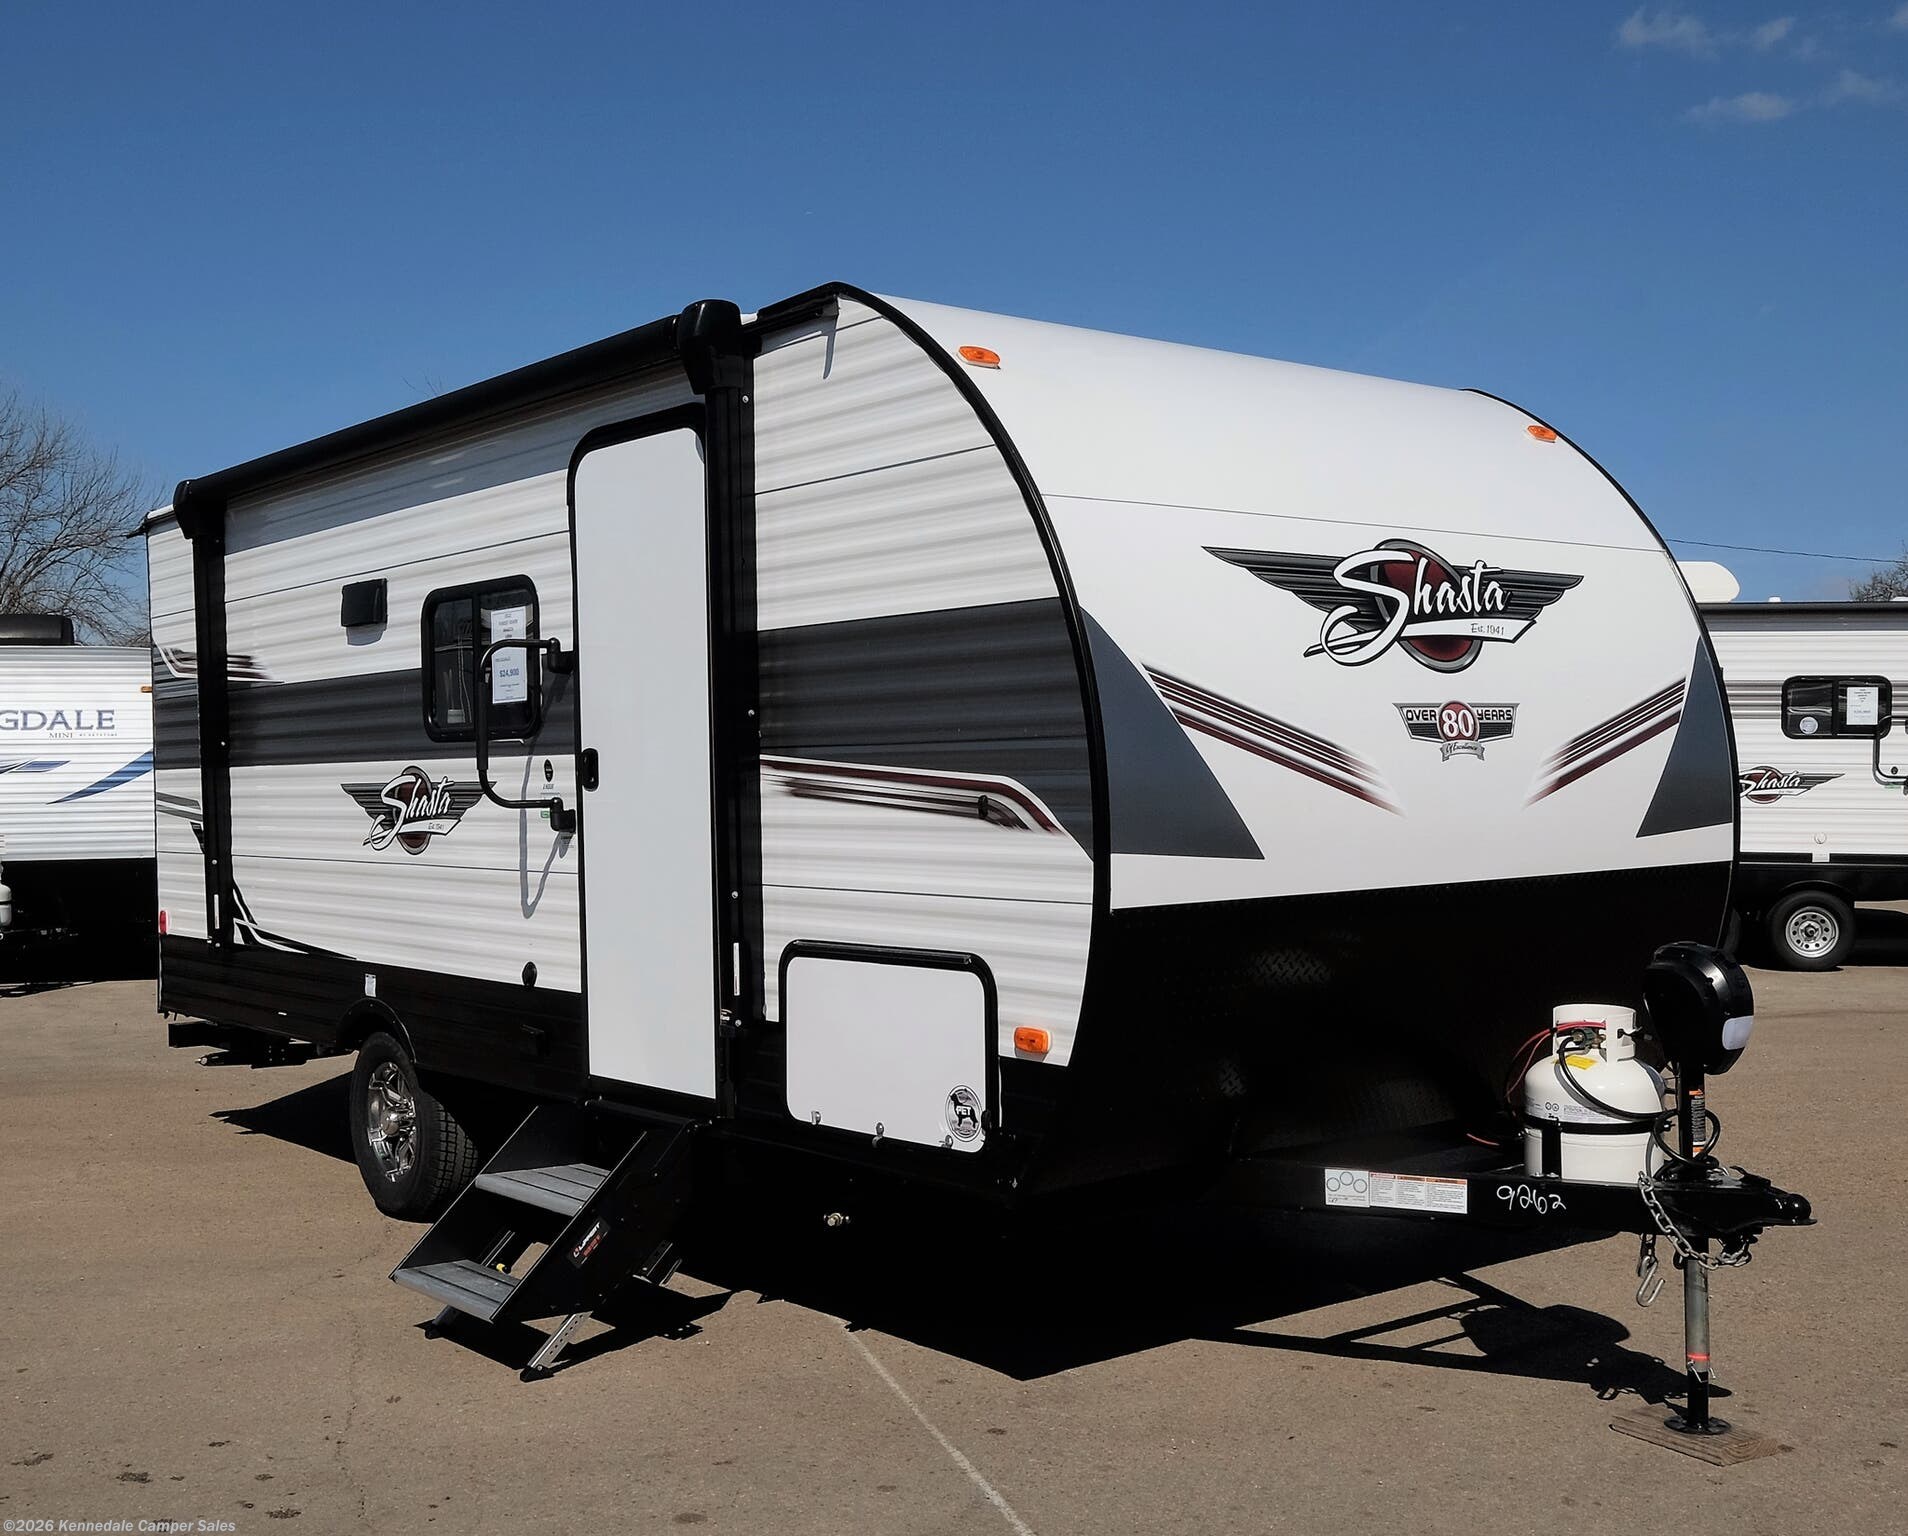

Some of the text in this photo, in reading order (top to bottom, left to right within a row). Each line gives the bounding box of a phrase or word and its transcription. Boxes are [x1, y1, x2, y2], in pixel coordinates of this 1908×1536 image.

[1304, 547, 1508, 667] Shasta
[0, 709, 115, 731] GDALE
[1405, 709, 1513, 738] OVER 80 YEARS
[363, 773, 455, 851] Shasta
[956, 1106, 972, 1116] PET
[1496, 1184, 1567, 1215] 9262
